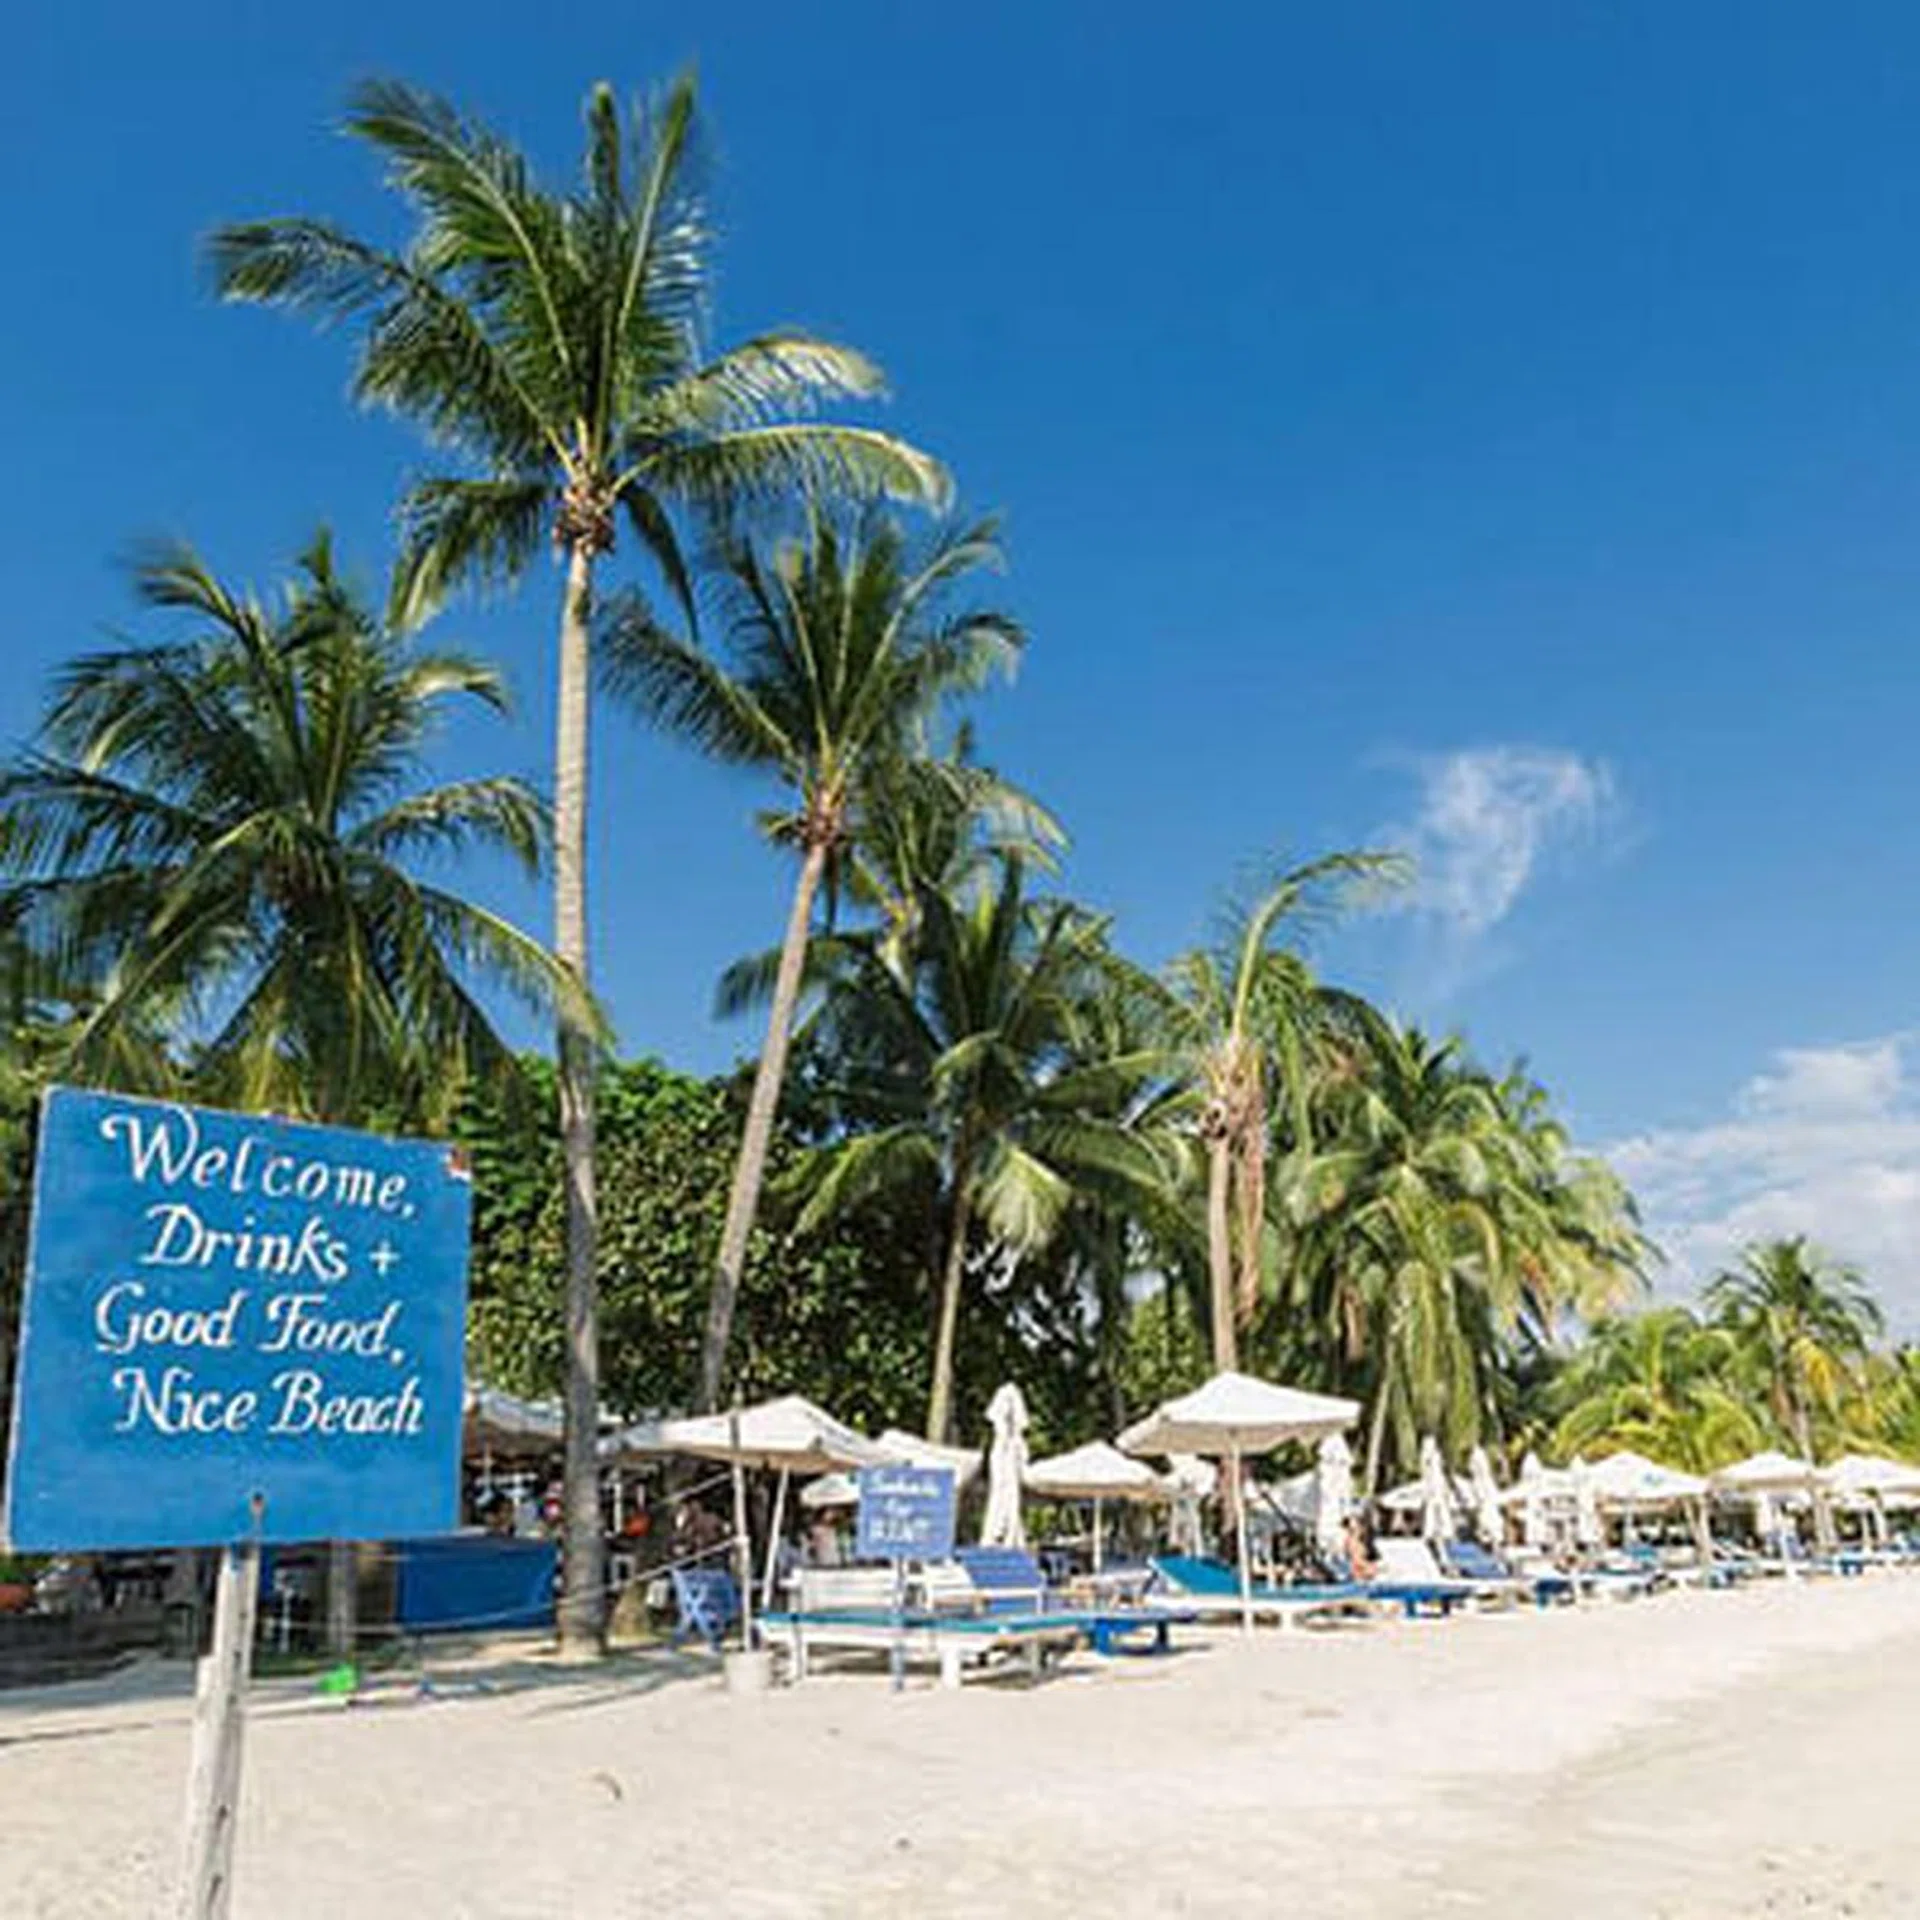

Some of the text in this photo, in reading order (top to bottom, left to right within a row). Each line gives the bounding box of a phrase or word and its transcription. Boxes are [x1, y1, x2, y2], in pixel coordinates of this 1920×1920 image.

[141, 1203, 400, 1282] Drinks +
[95, 1282, 248, 1353] Good
[112, 1366, 424, 1435] Nice Beach
